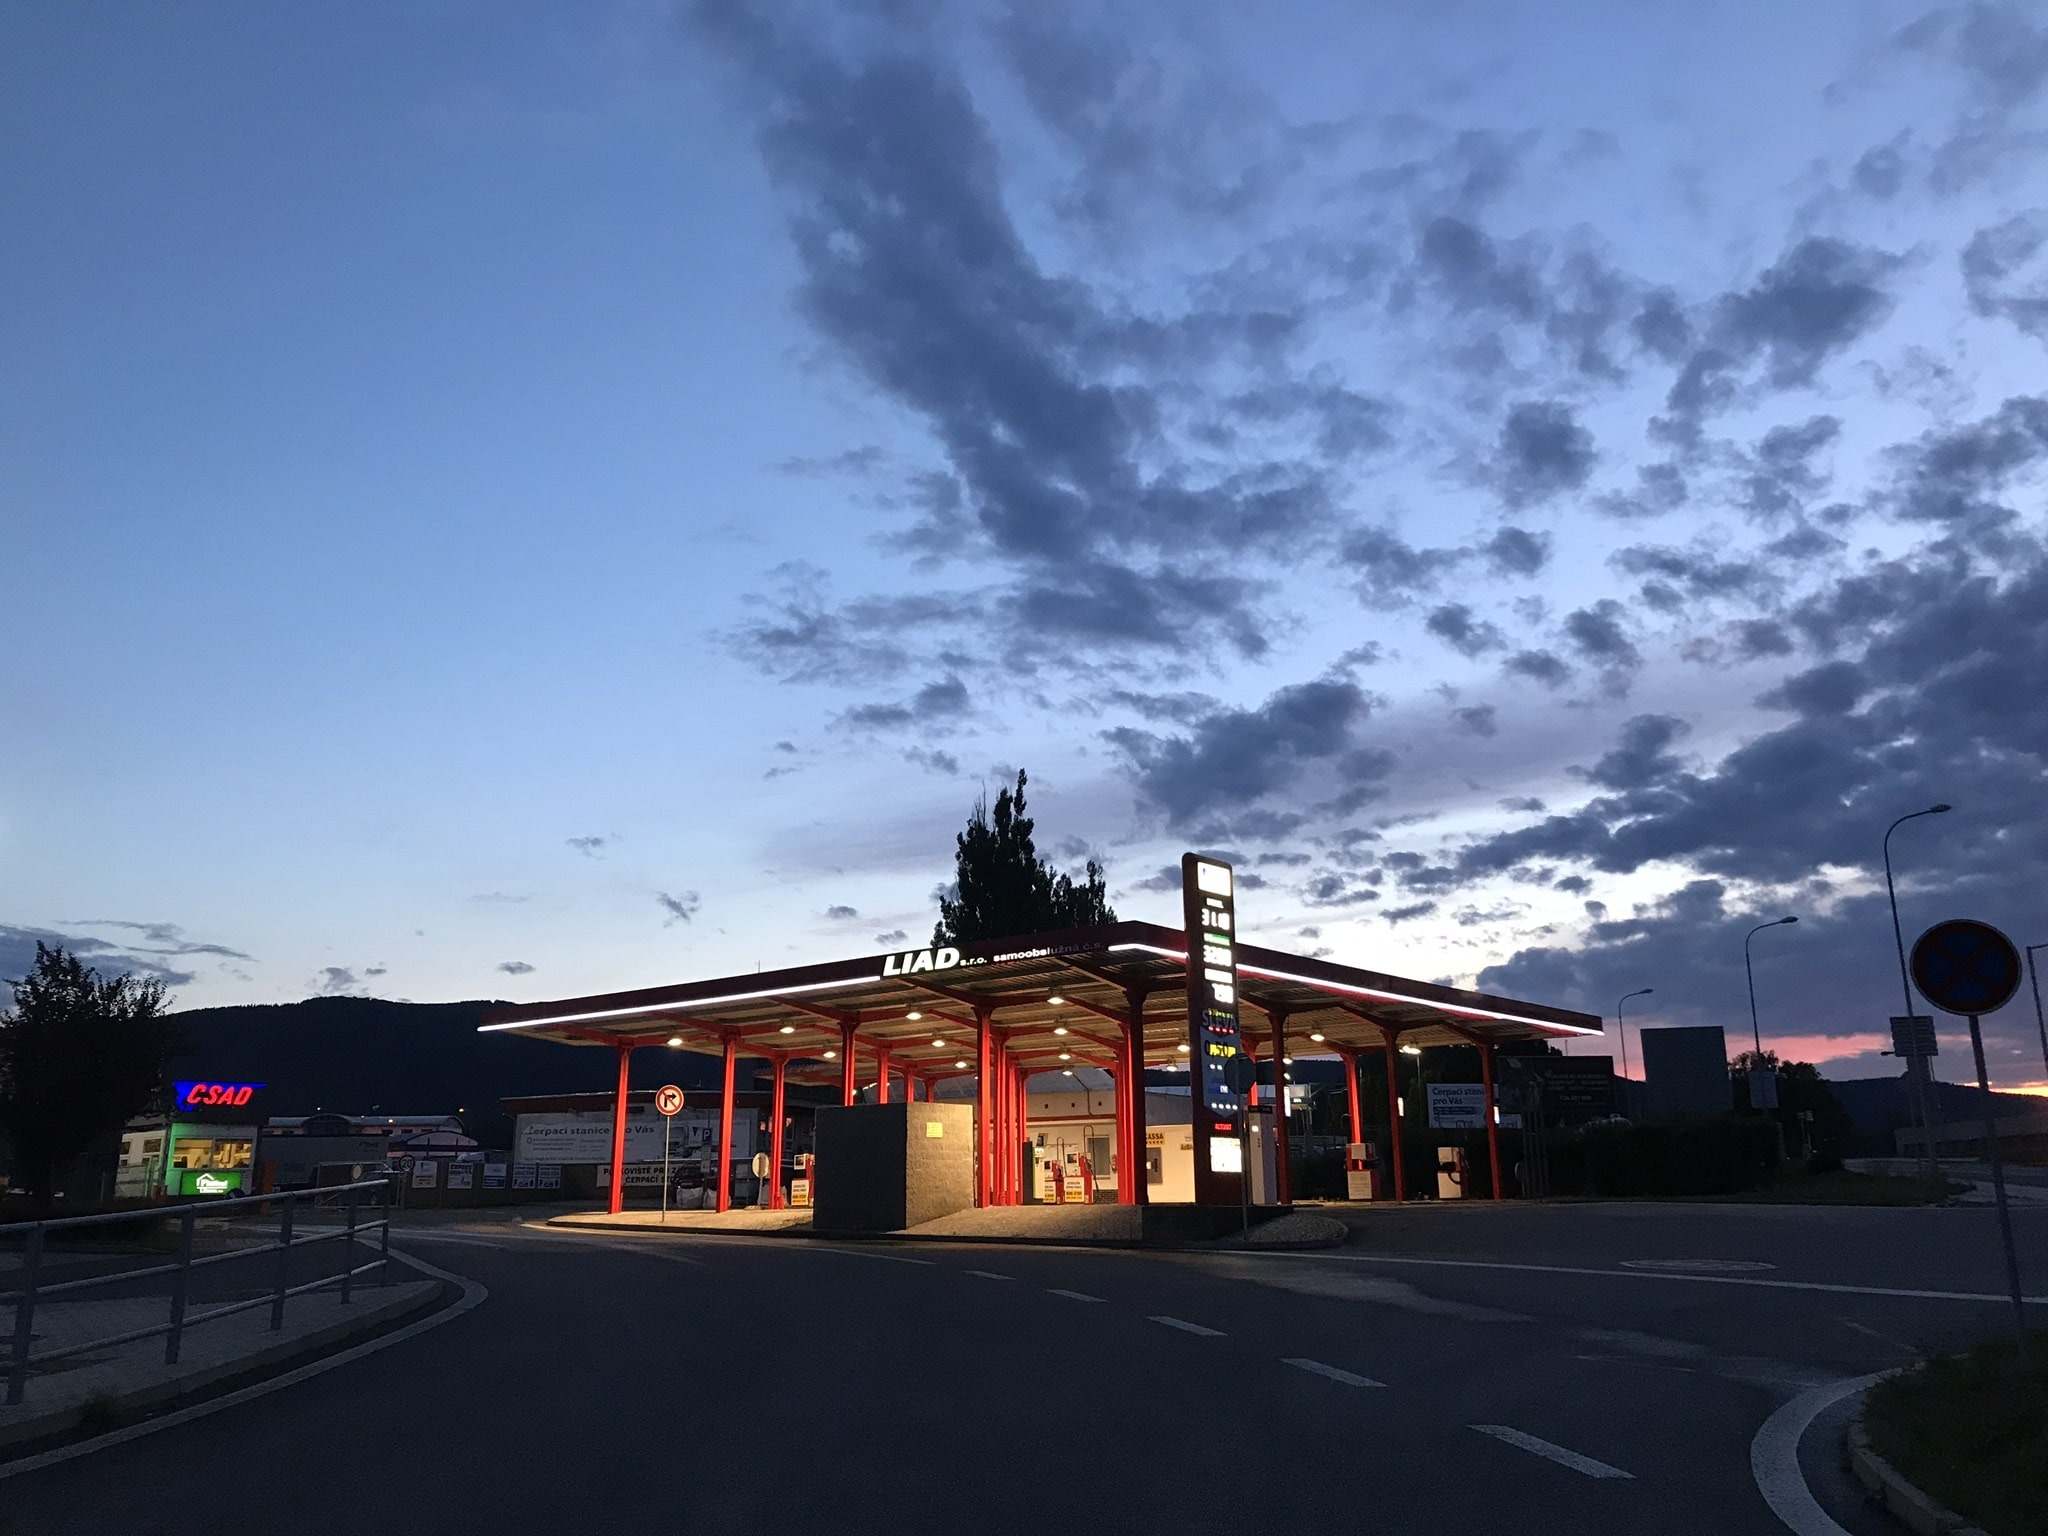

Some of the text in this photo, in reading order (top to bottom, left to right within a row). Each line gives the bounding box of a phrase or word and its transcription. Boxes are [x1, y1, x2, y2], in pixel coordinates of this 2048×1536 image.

[883, 947, 960, 977] LIAD
[960, 956, 987, 967] s.r.o.
[187, 1083, 254, 1106] CSAD
[570, 1125, 610, 1136] stanice
